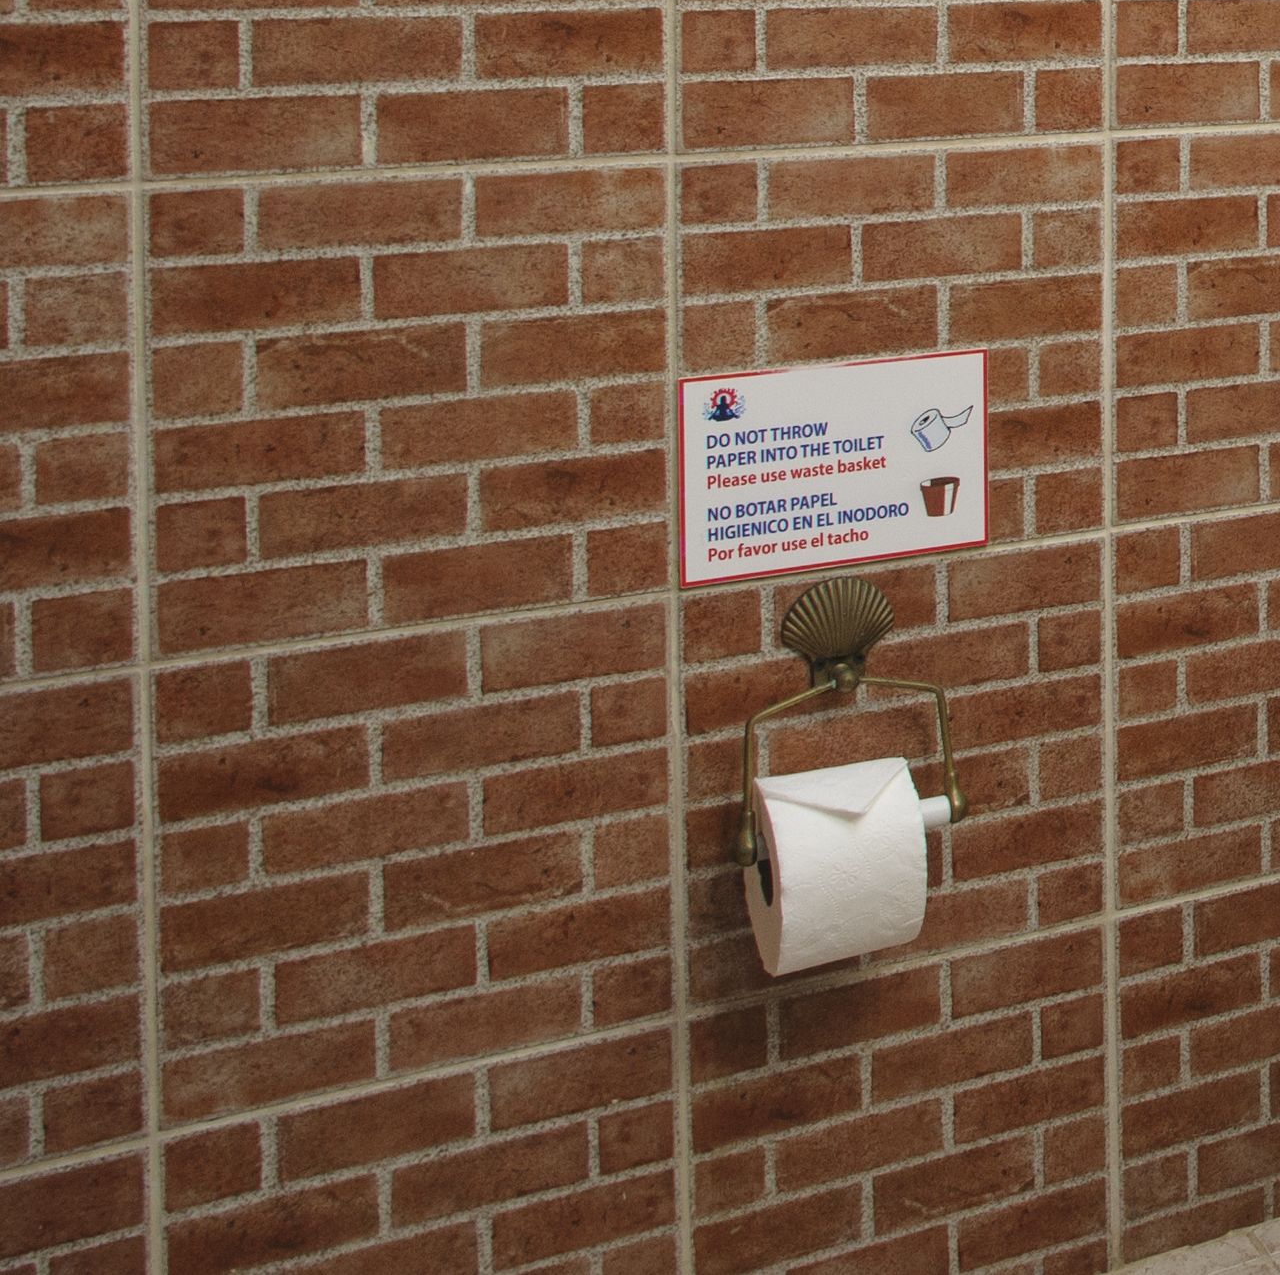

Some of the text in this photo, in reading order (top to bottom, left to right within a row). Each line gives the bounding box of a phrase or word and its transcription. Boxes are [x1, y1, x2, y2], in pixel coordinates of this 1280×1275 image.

[706, 421, 828, 450] DO NOT THROW
[706, 435, 884, 469] PAPER INTO THE TOILET
[707, 456, 887, 490] Please use waste basket
[707, 492, 838, 522] NO BOTAR PAPEL
[707, 502, 909, 542] HIGIENICO EN EL INODORO
[708, 528, 869, 562] Por favor use el tacho
